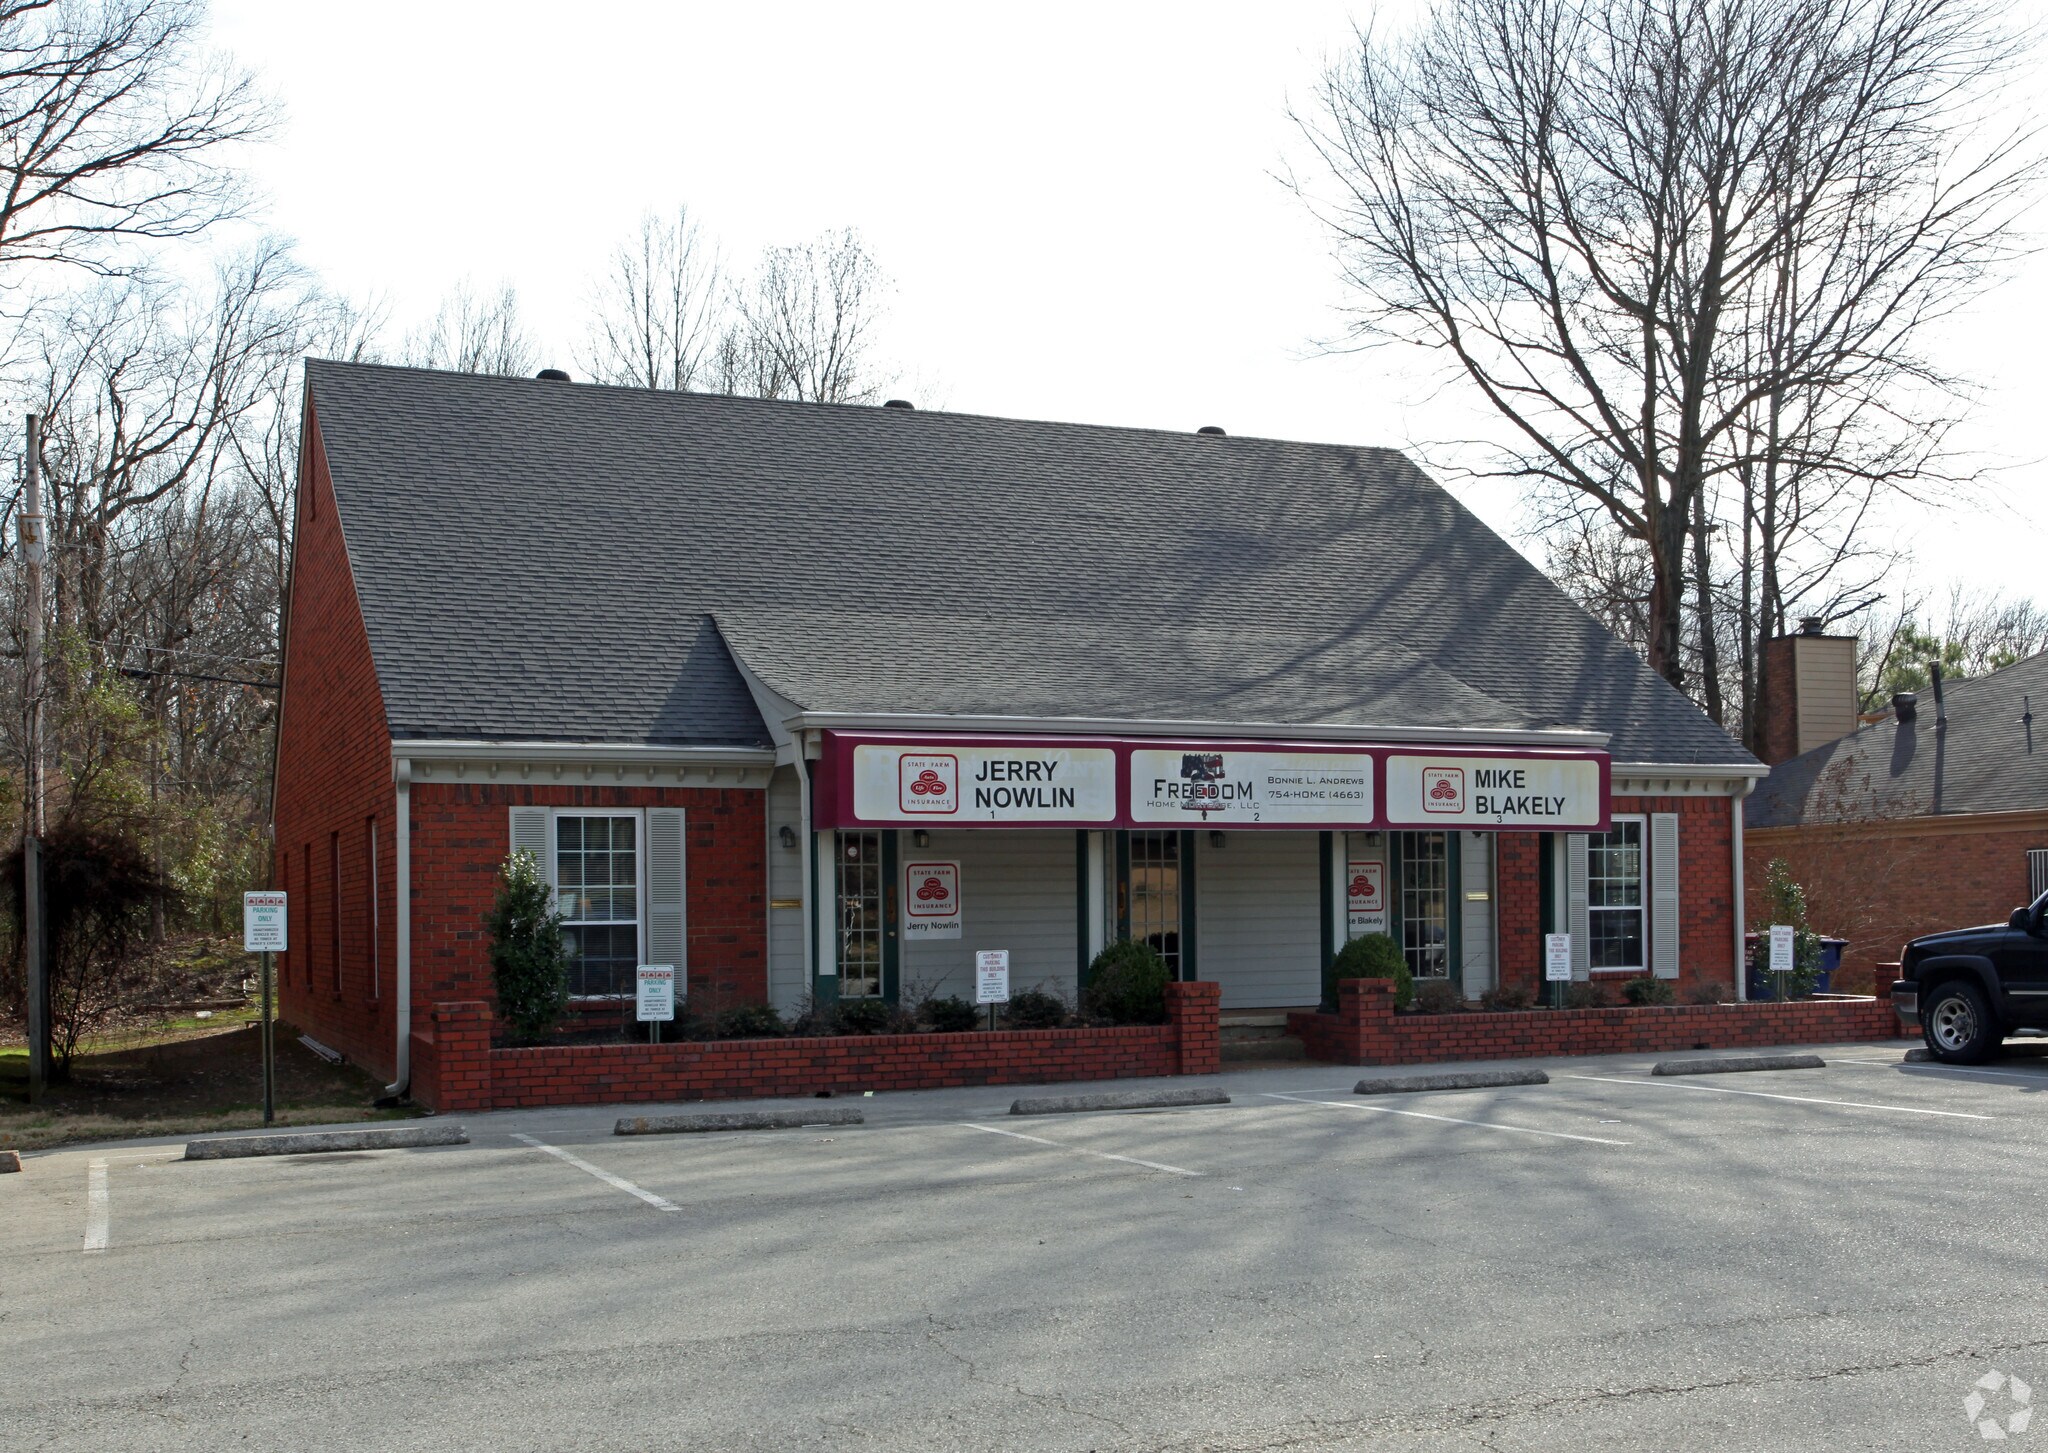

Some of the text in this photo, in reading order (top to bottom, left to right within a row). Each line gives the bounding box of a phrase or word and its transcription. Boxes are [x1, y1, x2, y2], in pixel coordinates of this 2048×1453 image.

[975, 761, 1058, 781] JERRY
[1475, 770, 1526, 788] MIKE
[1154, 779, 1252, 800] FREEDOM
[975, 787, 1075, 808] NOWLIN
[1268, 791, 1364, 799] 754-HOME (4663)
[1476, 796, 1566, 815] BLAKELY
[990, 811, 995, 819] 1
[1254, 813, 1260, 821] 2
[1496, 815, 1503, 824] 3
[1358, 917, 1383, 925] Blakely
[907, 922, 929, 931] Jerry
